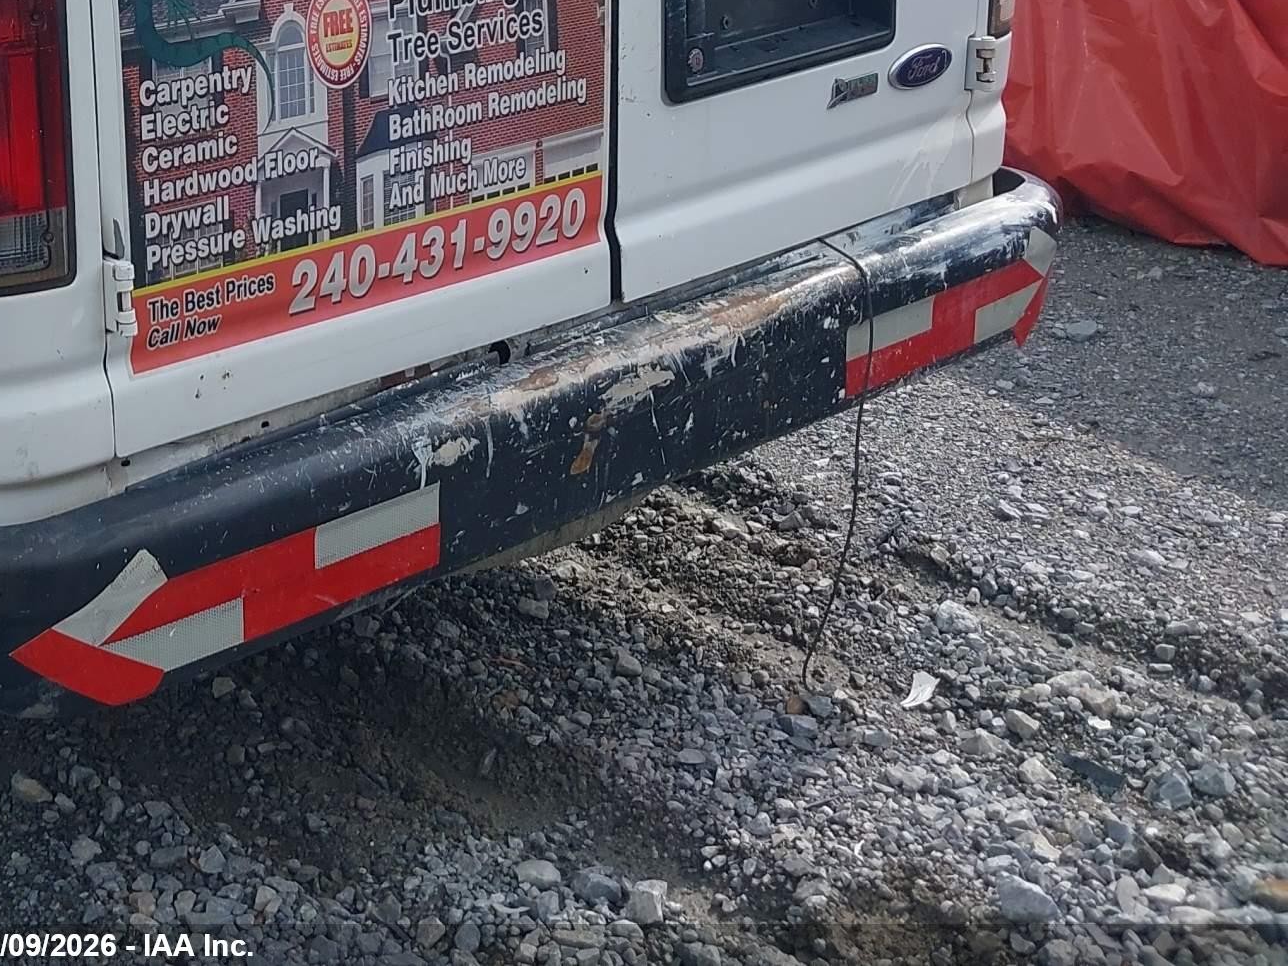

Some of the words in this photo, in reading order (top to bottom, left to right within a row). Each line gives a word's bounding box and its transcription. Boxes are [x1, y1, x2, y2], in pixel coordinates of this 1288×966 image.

[323, 8, 353, 37] FREE
[386, 29, 441, 64] Tree
[447, 9, 544, 53] Services
[139, 64, 252, 106] Carpentry
[388, 69, 459, 107] Kitchen
[464, 47, 566, 89] Remodeling
[141, 101, 229, 141] Electric
[389, 100, 482, 141] BathRoom
[488, 77, 587, 118] Remodeling
[142, 132, 238, 173] Ceramic
[144, 157, 258, 206] Hardwood
[265, 147, 318, 178] Floor
[389, 135, 472, 176] Finishing
[389, 171, 424, 210] And
[430, 163, 478, 199] Much
[483, 156, 525, 185] More
[145, 195, 229, 239] Drywall
[147, 228, 245, 271] Pressure
[252, 204, 341, 243] Washing
[289, 188, 586, 315] 240-431-9920
[148, 296, 179, 323] The
[183, 285, 221, 313] Best
[225, 274, 275, 303] Prices
[147, 323, 181, 349] Call
[184, 315, 223, 338] Now
